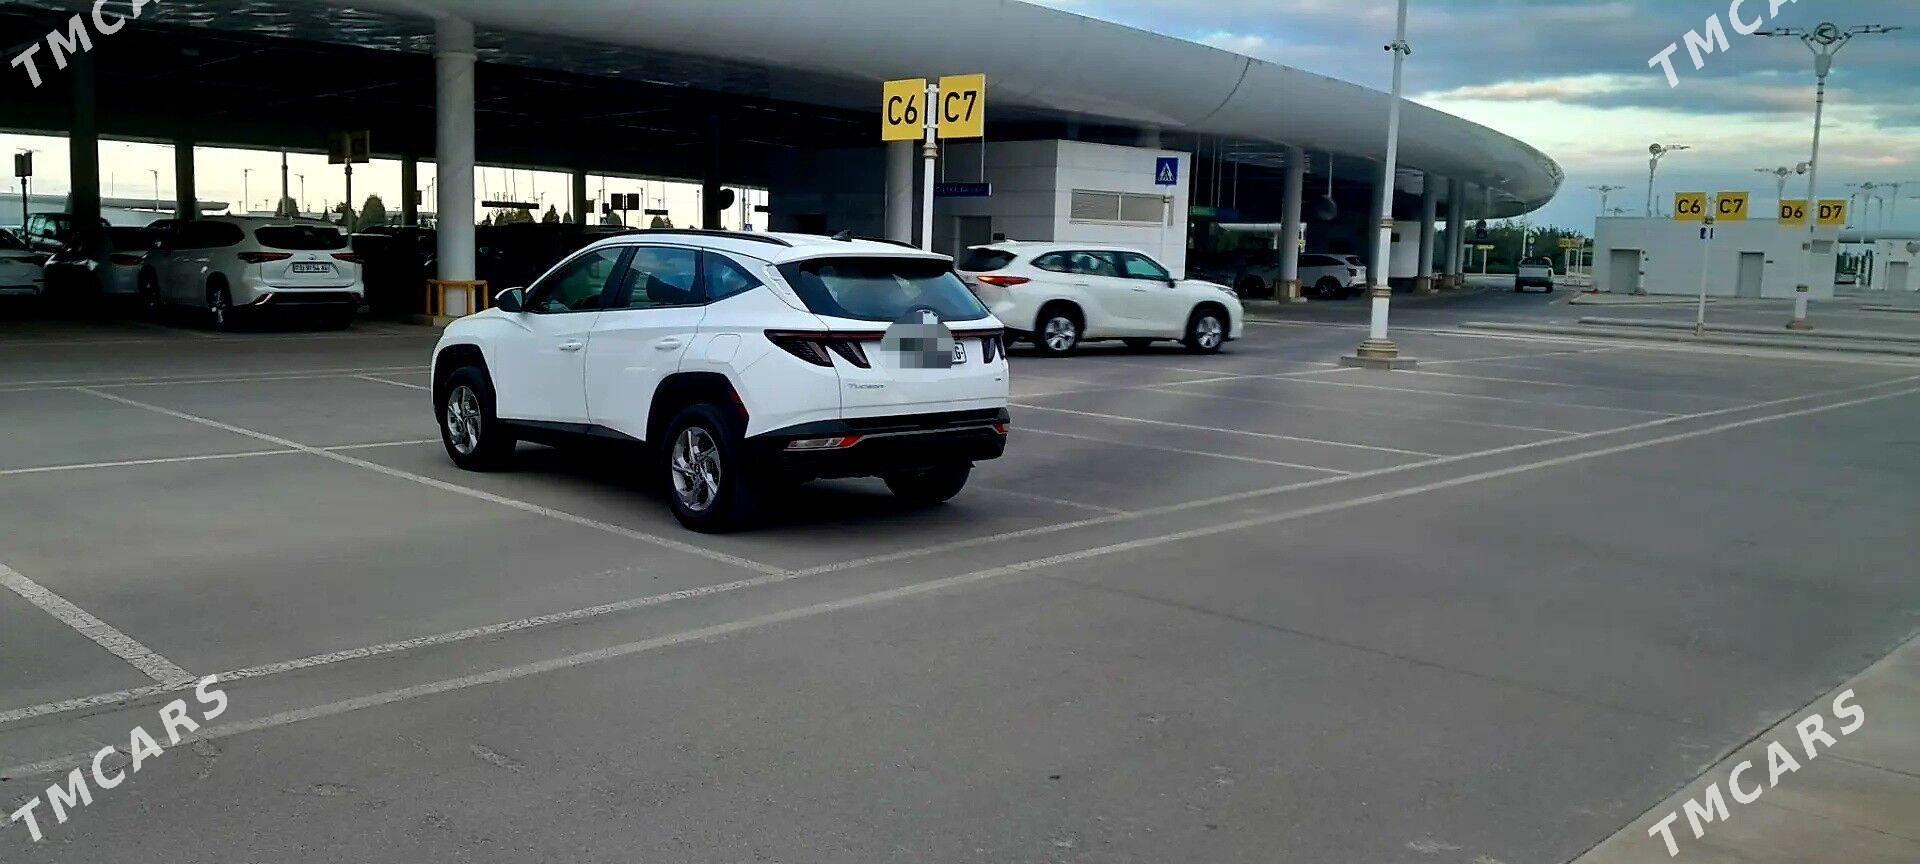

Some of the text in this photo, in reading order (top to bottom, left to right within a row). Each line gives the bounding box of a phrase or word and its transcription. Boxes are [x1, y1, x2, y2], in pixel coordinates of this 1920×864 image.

[888, 95, 918, 125] C6
[945, 91, 977, 122] C7
[1678, 199, 1701, 214] C6
[1719, 198, 1744, 214] C7
[1781, 205, 1803, 219] D6
[1819, 205, 1843, 219] D7
